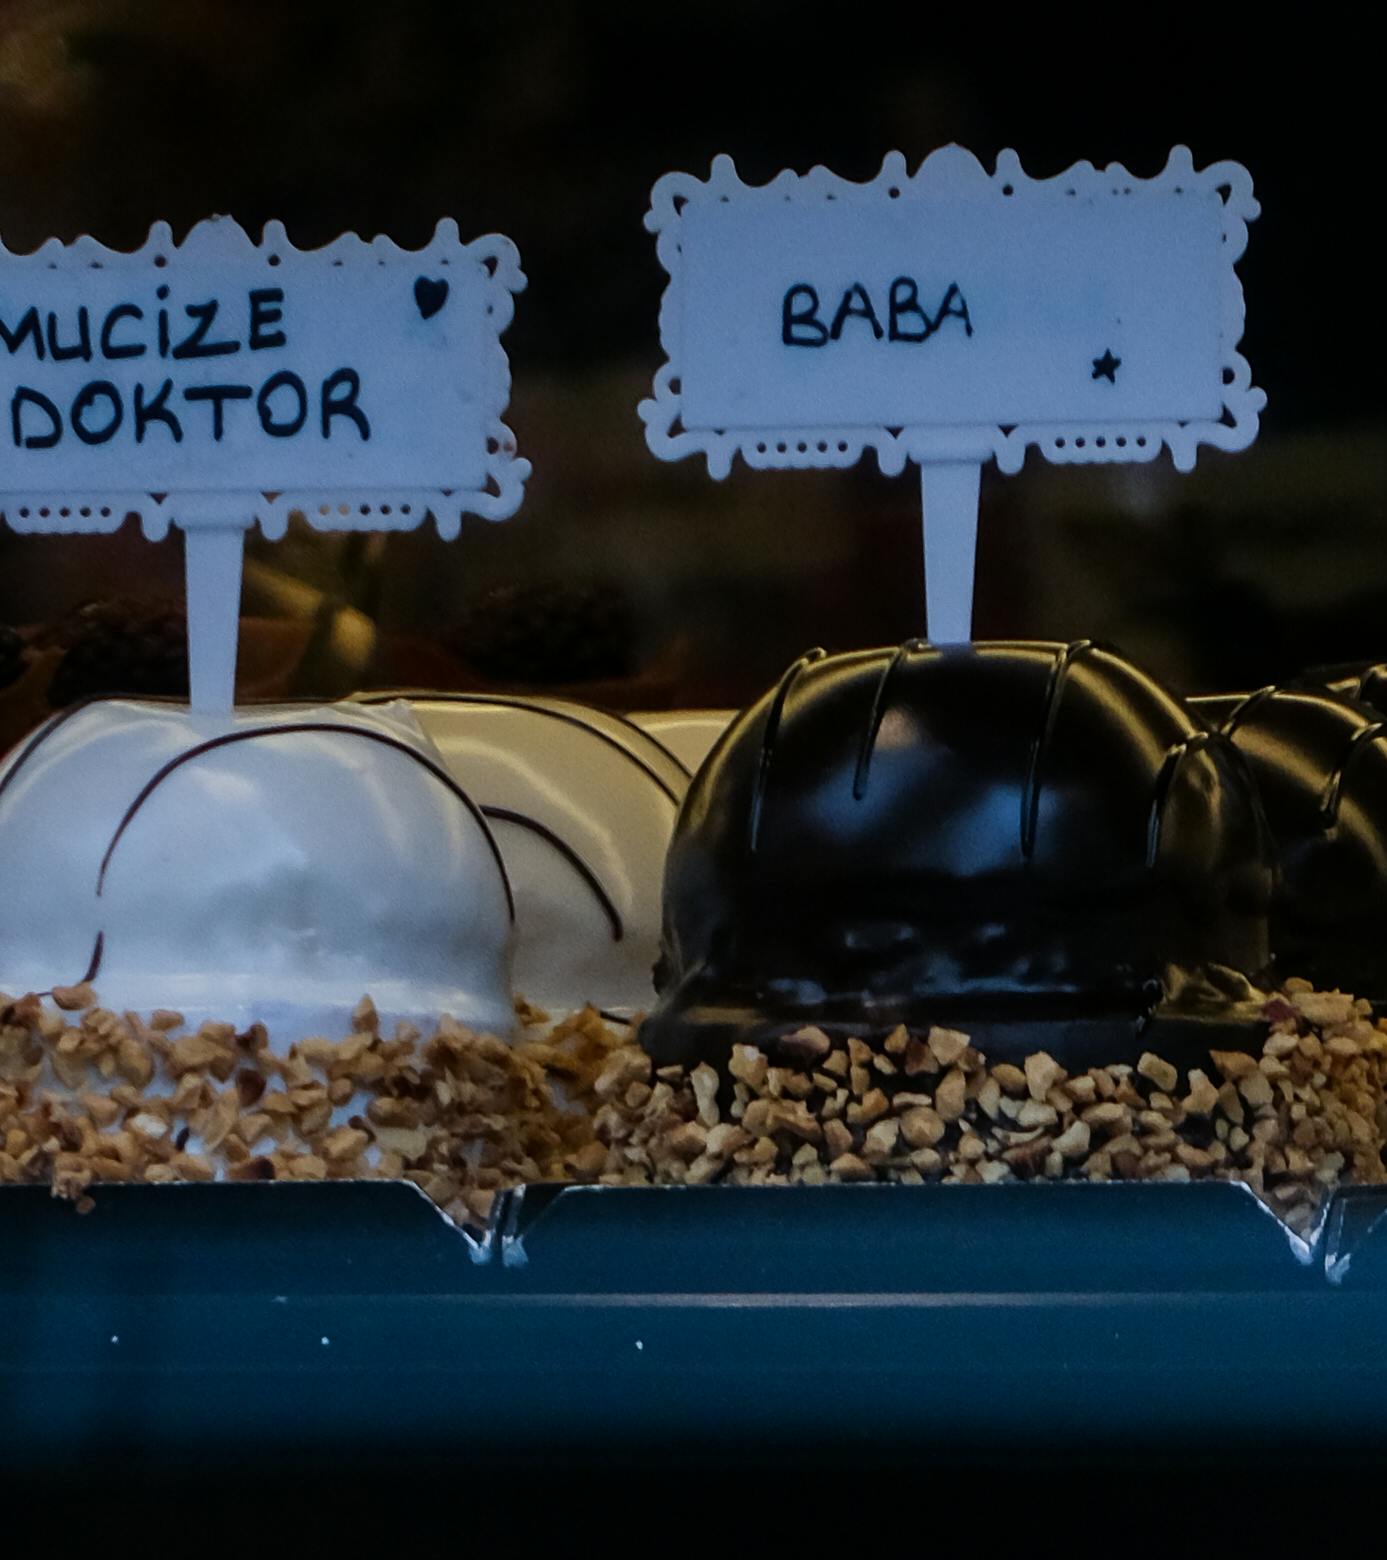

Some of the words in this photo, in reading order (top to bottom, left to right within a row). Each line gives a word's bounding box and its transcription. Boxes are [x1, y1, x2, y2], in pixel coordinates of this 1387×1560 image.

[0, 284, 286, 361] MUCİZE
[782, 276, 972, 346] BABA
[11, 368, 370, 449] DOKTOR
